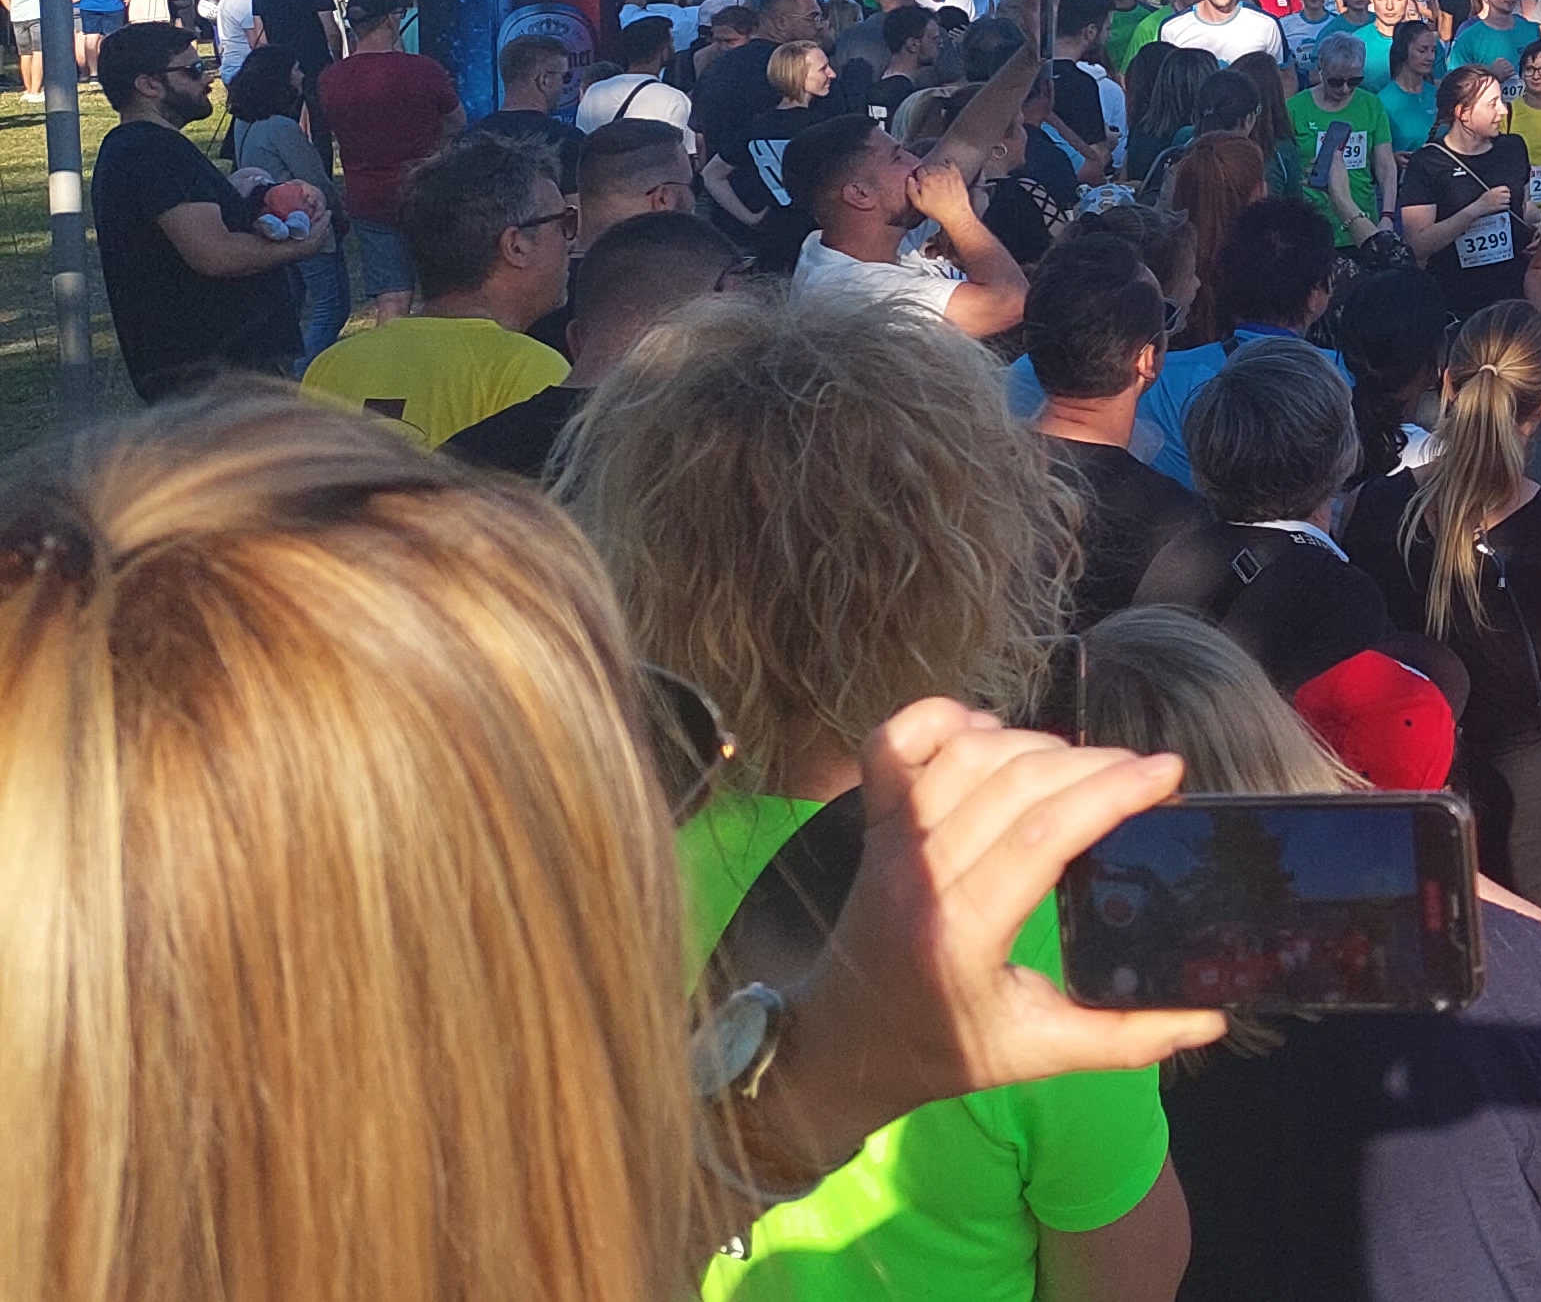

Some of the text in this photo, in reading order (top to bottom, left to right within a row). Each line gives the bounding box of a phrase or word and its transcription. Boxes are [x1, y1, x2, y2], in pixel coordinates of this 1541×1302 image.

[1502, 85, 1524, 97] 407
[1344, 145, 1361, 158] 39
[1464, 231, 1507, 253] 3299
